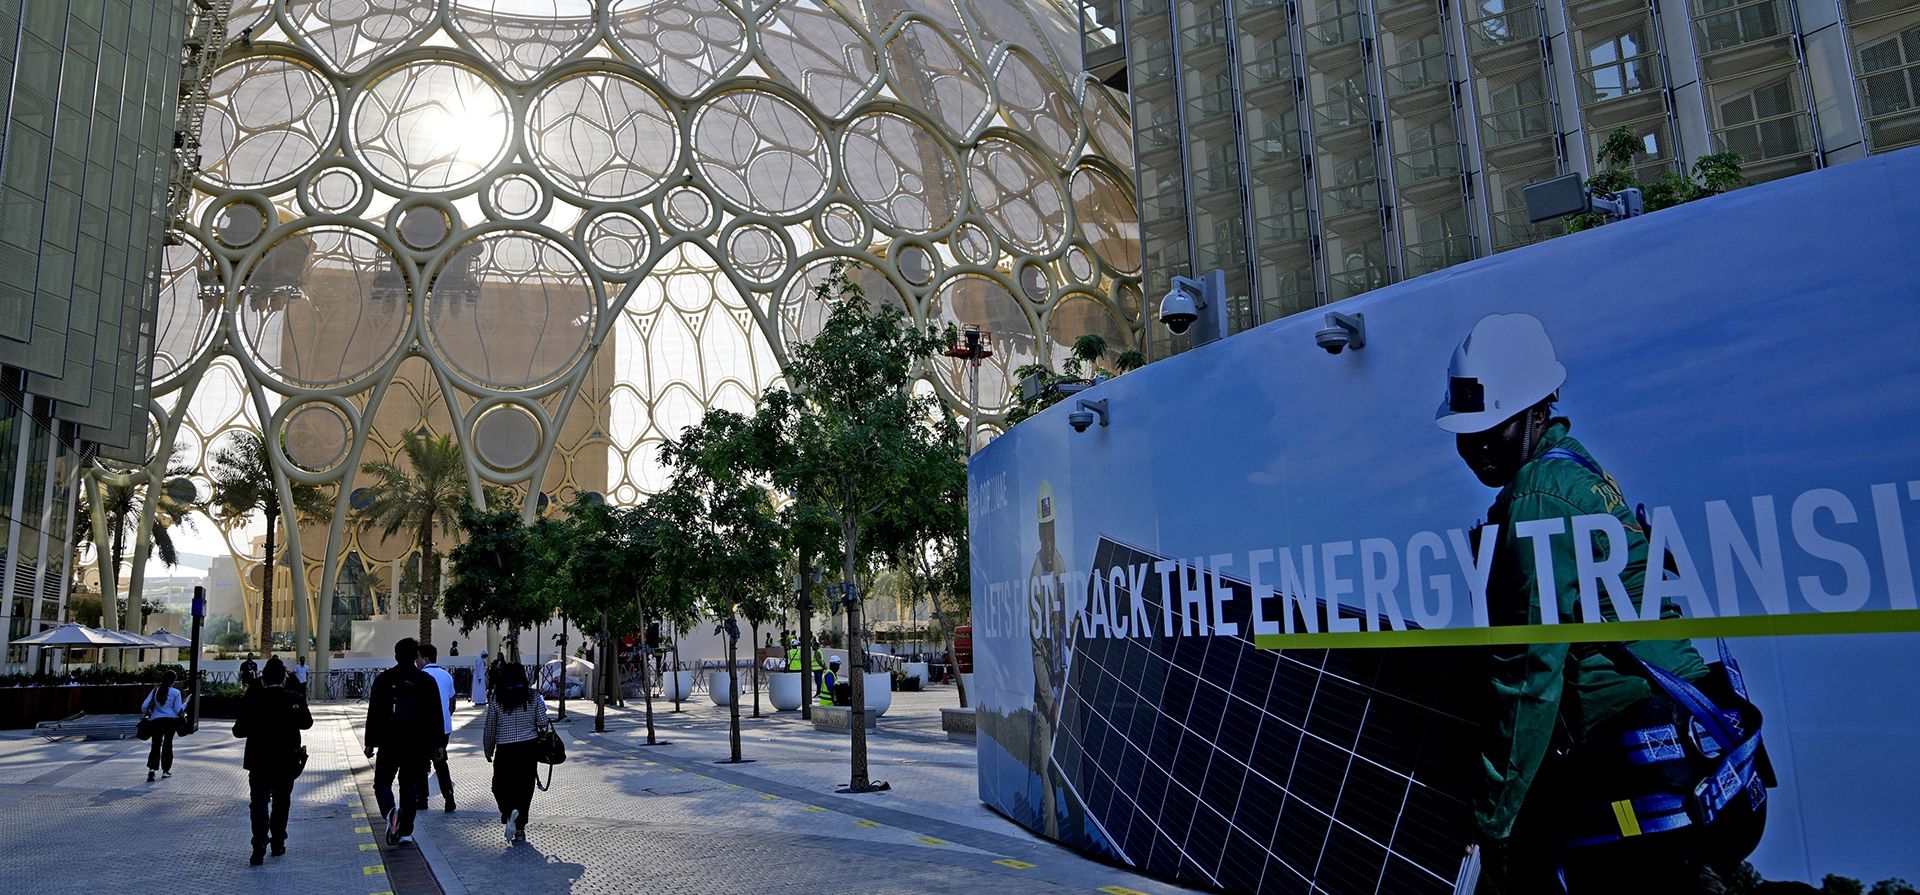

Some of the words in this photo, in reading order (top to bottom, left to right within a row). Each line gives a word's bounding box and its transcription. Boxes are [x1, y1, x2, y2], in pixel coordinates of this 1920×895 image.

[984, 580, 1012, 639] LET'S
[1013, 562, 1152, 640] FAST-TRACK
[1154, 552, 1239, 638] THE
[1248, 523, 1499, 635] ENERGY
